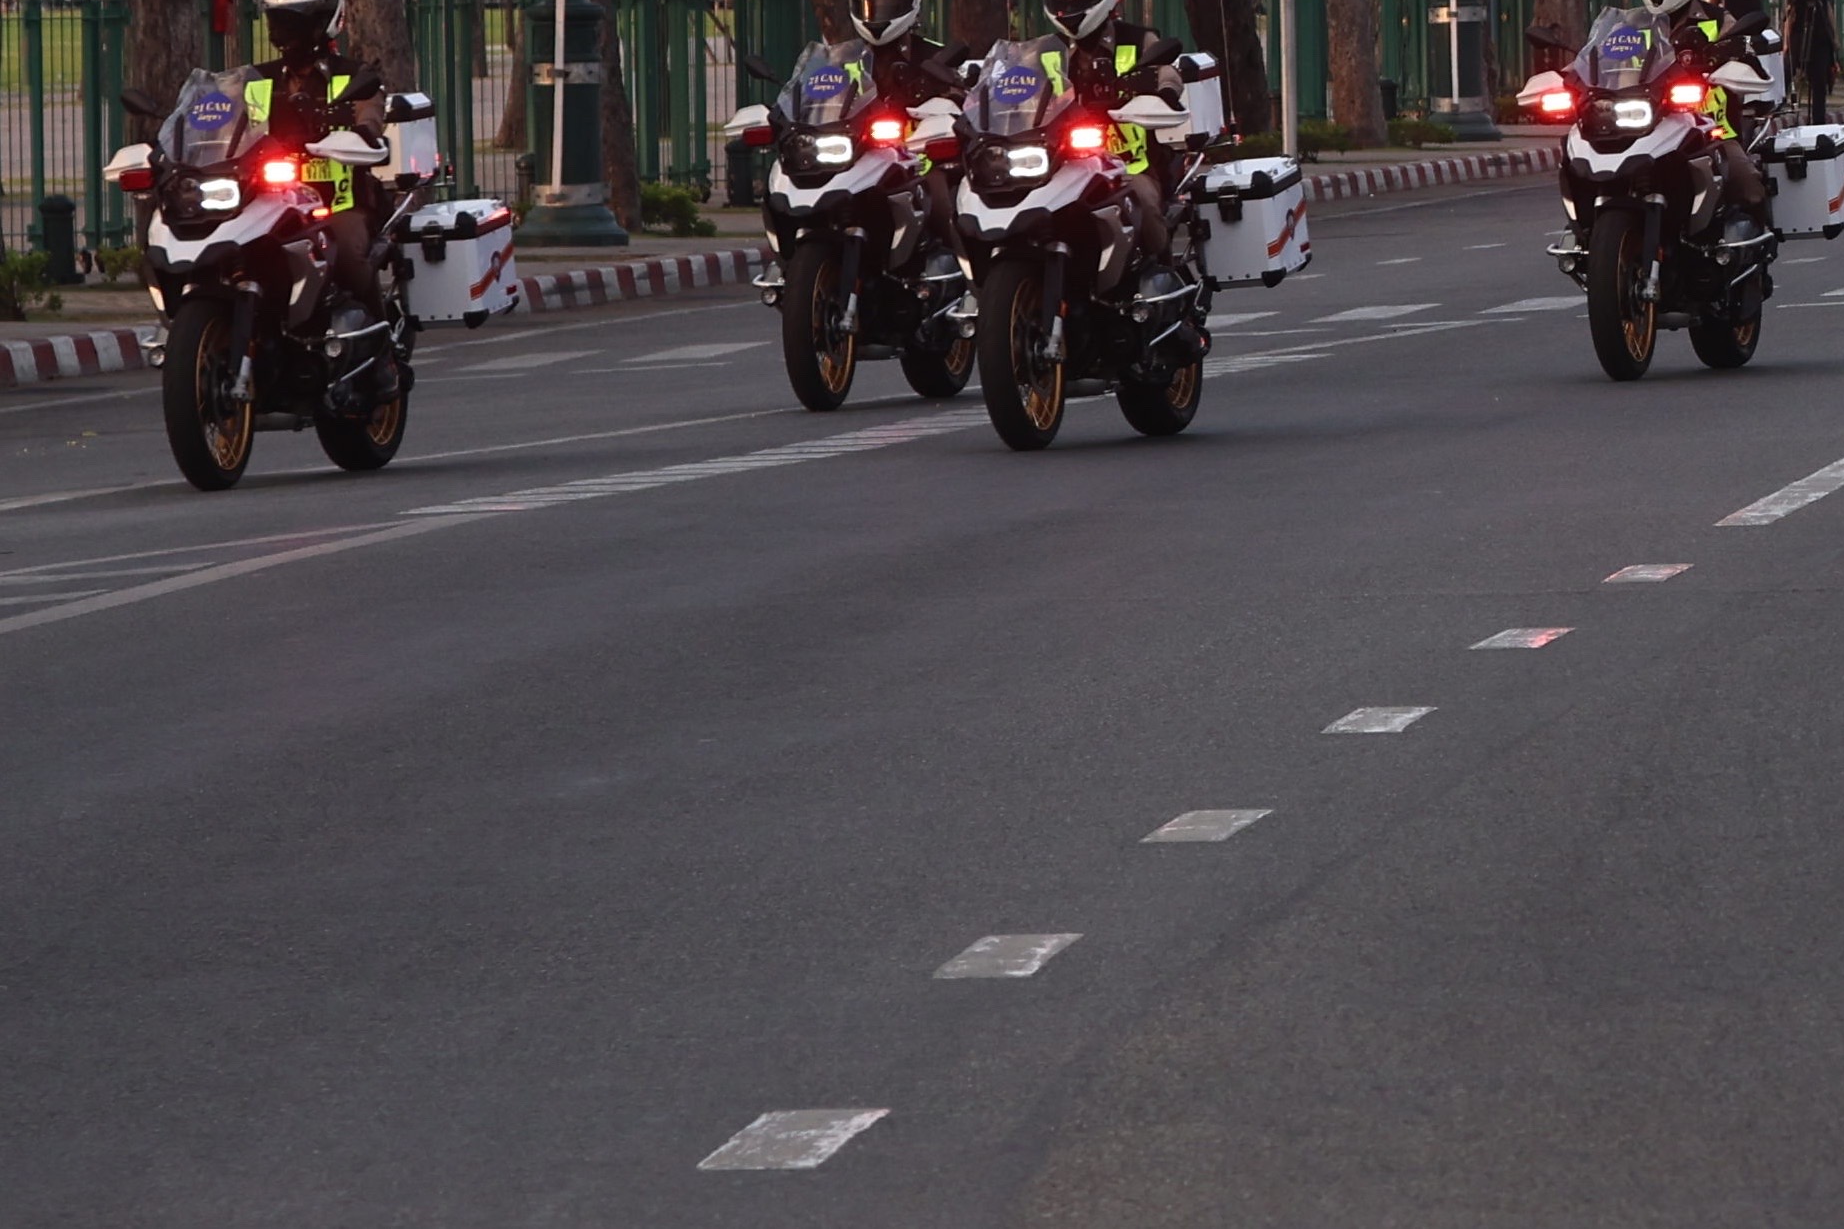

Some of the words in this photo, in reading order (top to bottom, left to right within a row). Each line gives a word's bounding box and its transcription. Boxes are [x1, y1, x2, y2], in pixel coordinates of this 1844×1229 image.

[1618, 35, 1641, 45] CAM
[820, 74, 843, 84] CAM
[1011, 75, 1036, 86] CAM
[206, 101, 231, 112] CAM
